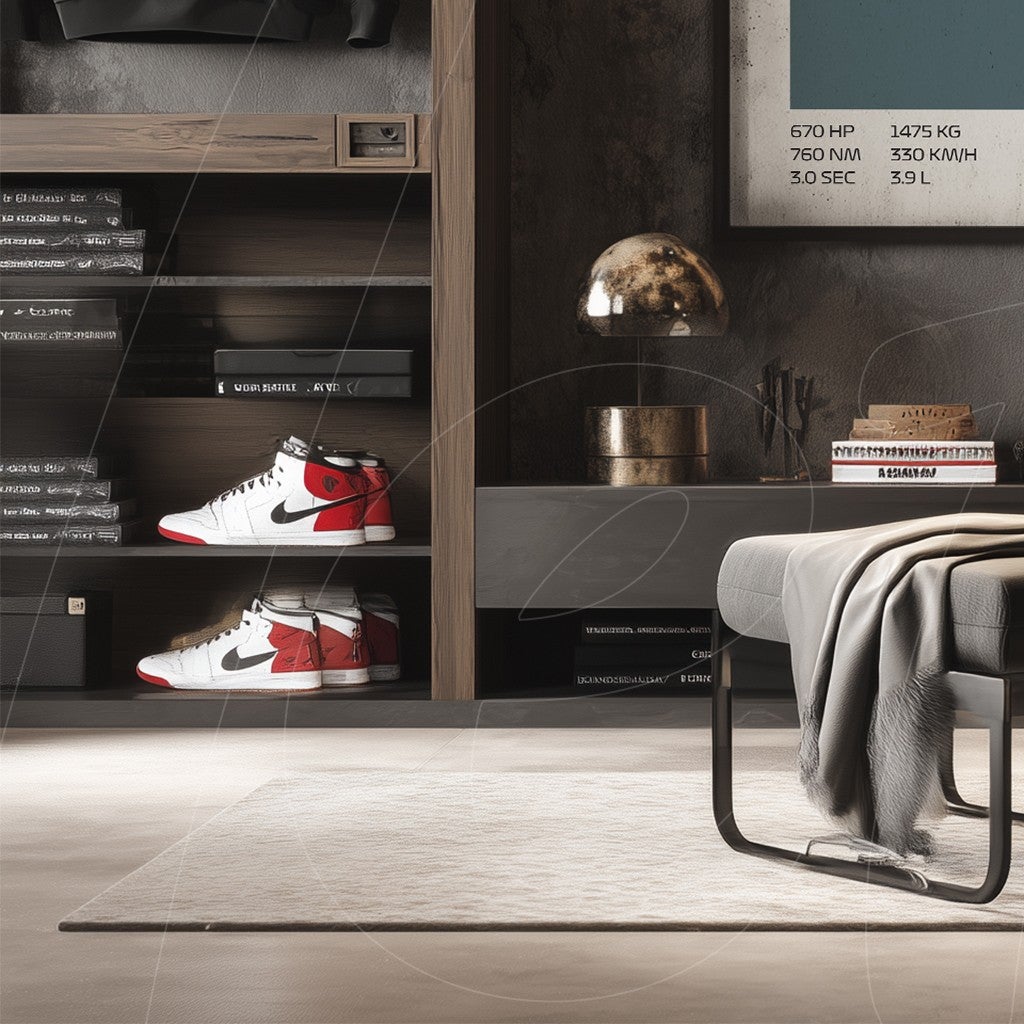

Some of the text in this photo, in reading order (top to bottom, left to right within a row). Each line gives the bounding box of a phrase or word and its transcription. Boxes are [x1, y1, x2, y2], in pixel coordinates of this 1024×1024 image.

[790, 124, 855, 138] 670 HP
[890, 124, 961, 139] 1475 KG
[790, 147, 861, 162] 760 NM
[890, 147, 977, 163] 330 KM/H
[790, 170, 856, 185] 3.0 SEC
[890, 170, 931, 185] 3.9 L
